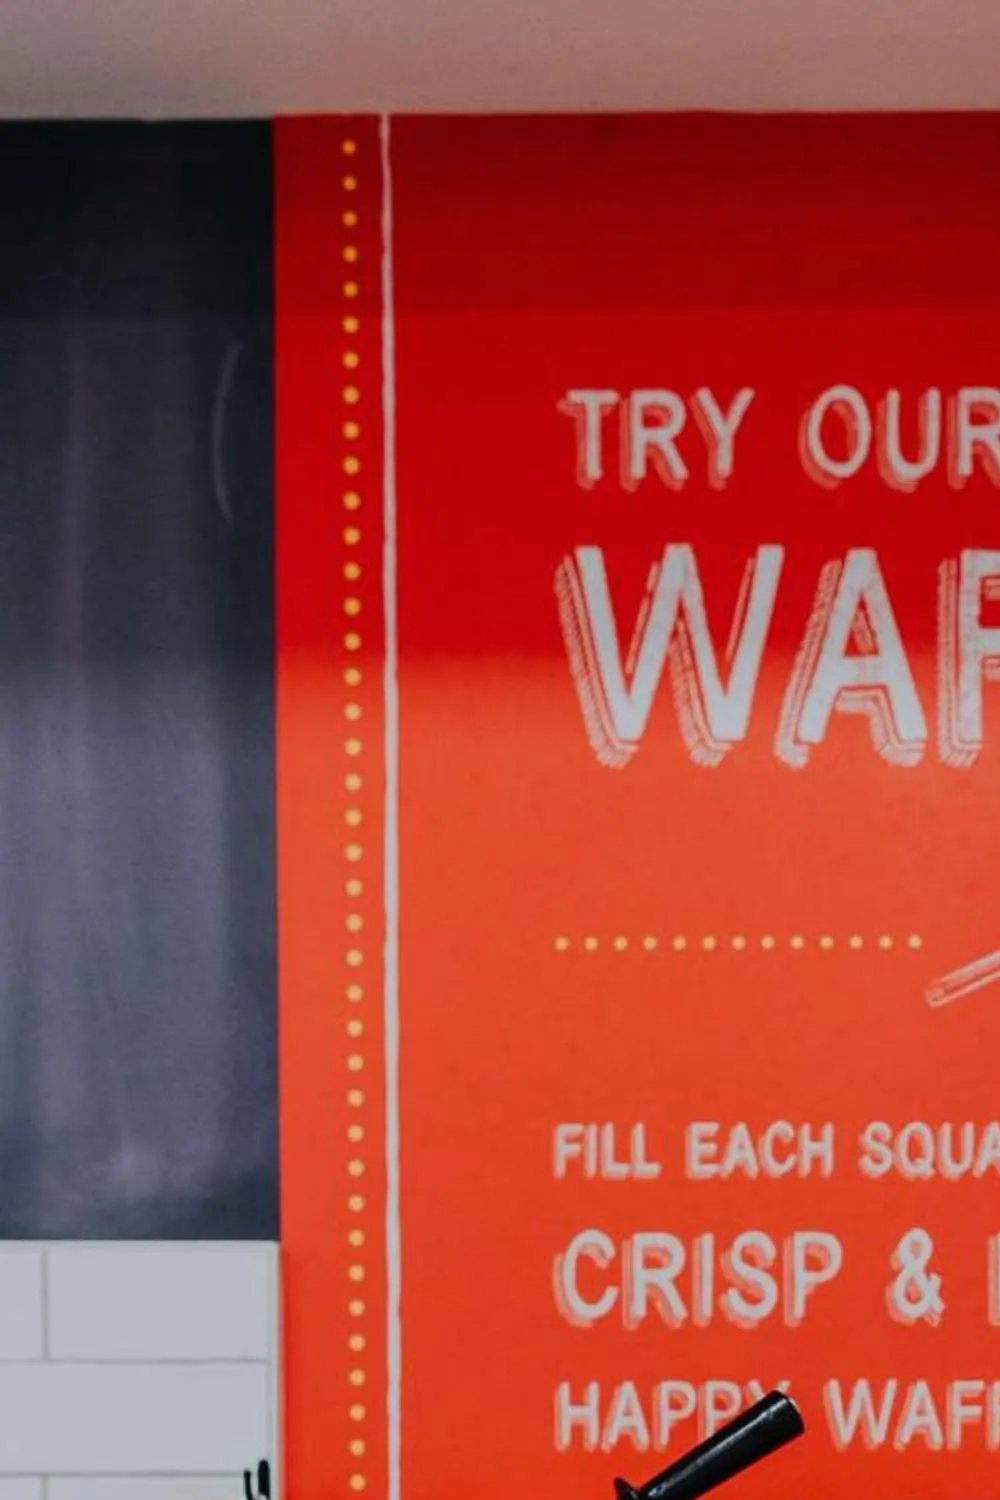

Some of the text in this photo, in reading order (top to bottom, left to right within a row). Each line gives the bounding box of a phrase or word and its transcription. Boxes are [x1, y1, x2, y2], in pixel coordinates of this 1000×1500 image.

[559, 385, 754, 491] TRY
[553, 1121, 660, 1179] FILL
[685, 1120, 834, 1178] EACH
[553, 1230, 843, 1329] CRISP
[887, 1227, 946, 1328] &
